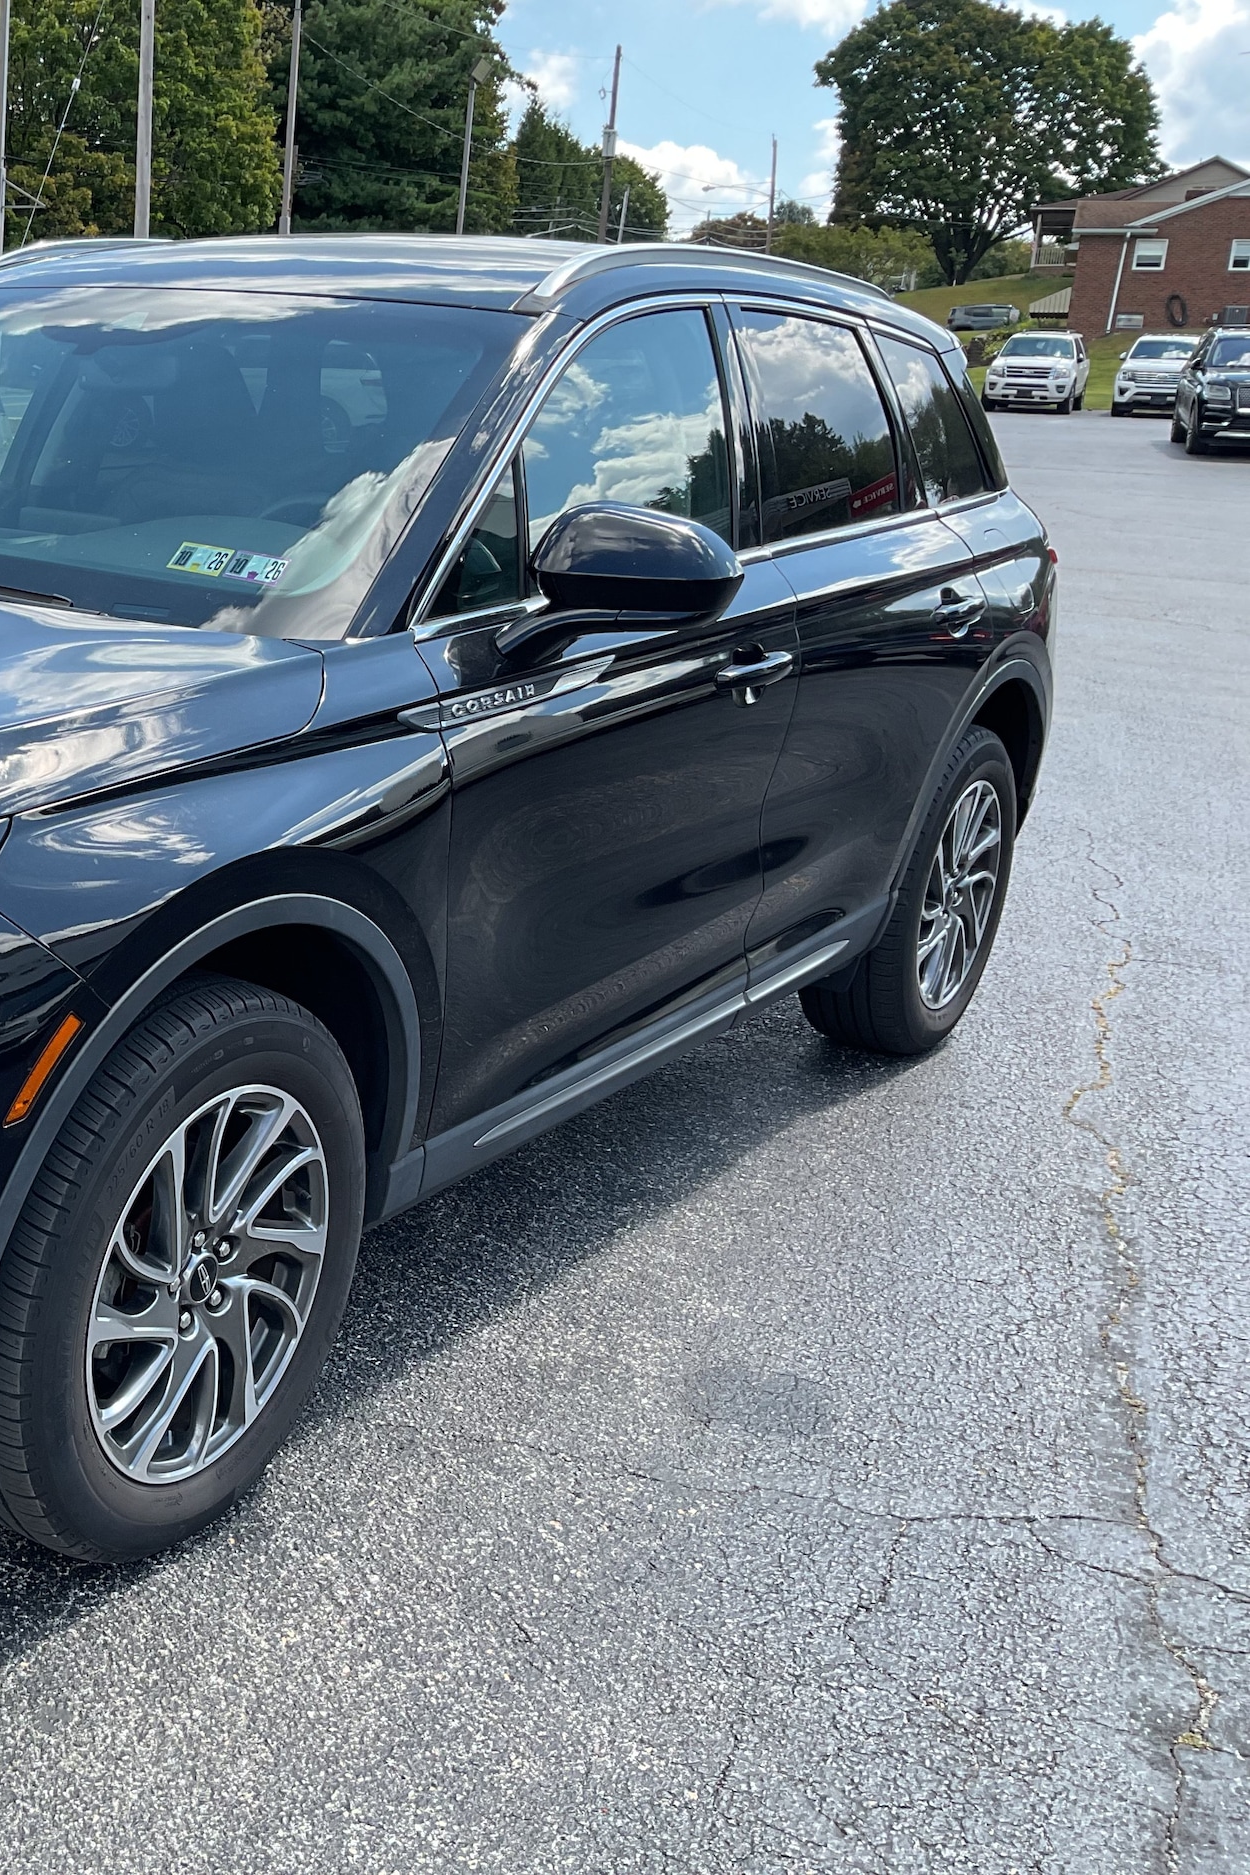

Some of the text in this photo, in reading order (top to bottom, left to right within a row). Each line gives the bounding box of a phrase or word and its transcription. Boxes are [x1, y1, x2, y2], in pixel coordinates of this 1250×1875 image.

[207, 552, 229, 571] 26
[265, 561, 286, 580] 26
[451, 684, 535, 718] CORSAIR
